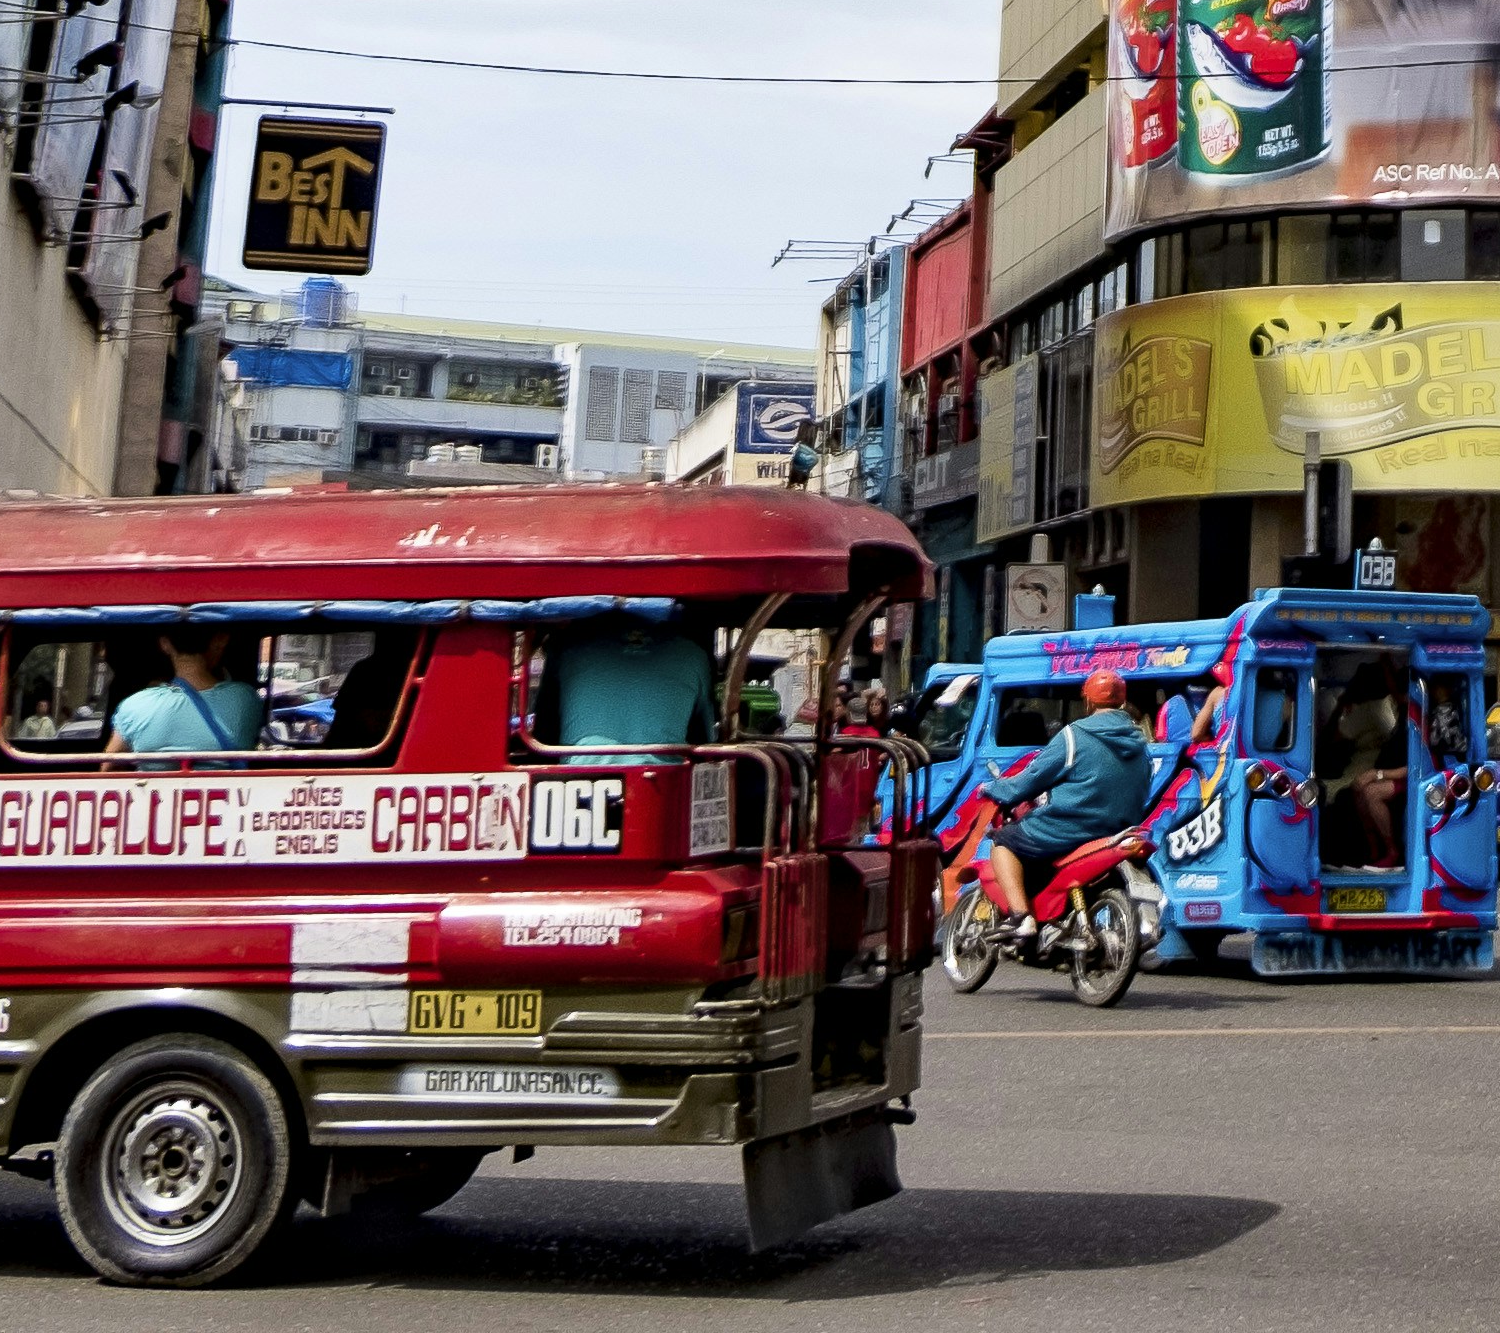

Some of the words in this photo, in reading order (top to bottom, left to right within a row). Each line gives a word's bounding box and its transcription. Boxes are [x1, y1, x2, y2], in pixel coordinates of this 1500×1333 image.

[1373, 164, 1412, 182] ASC
[1415, 162, 1447, 181] Ref
[288, 206, 371, 249] INN
[1132, 386, 1202, 434] GRILL
[1375, 434, 1447, 475] Real
[1360, 554, 1397, 588] 03B
[284, 786, 343, 809] JONES
[532, 778, 624, 851] 06C
[275, 834, 339, 856] ENGLIS
[1167, 799, 1223, 862] 03B
[413, 992, 466, 1030] GVG
[496, 992, 539, 1030] 109
